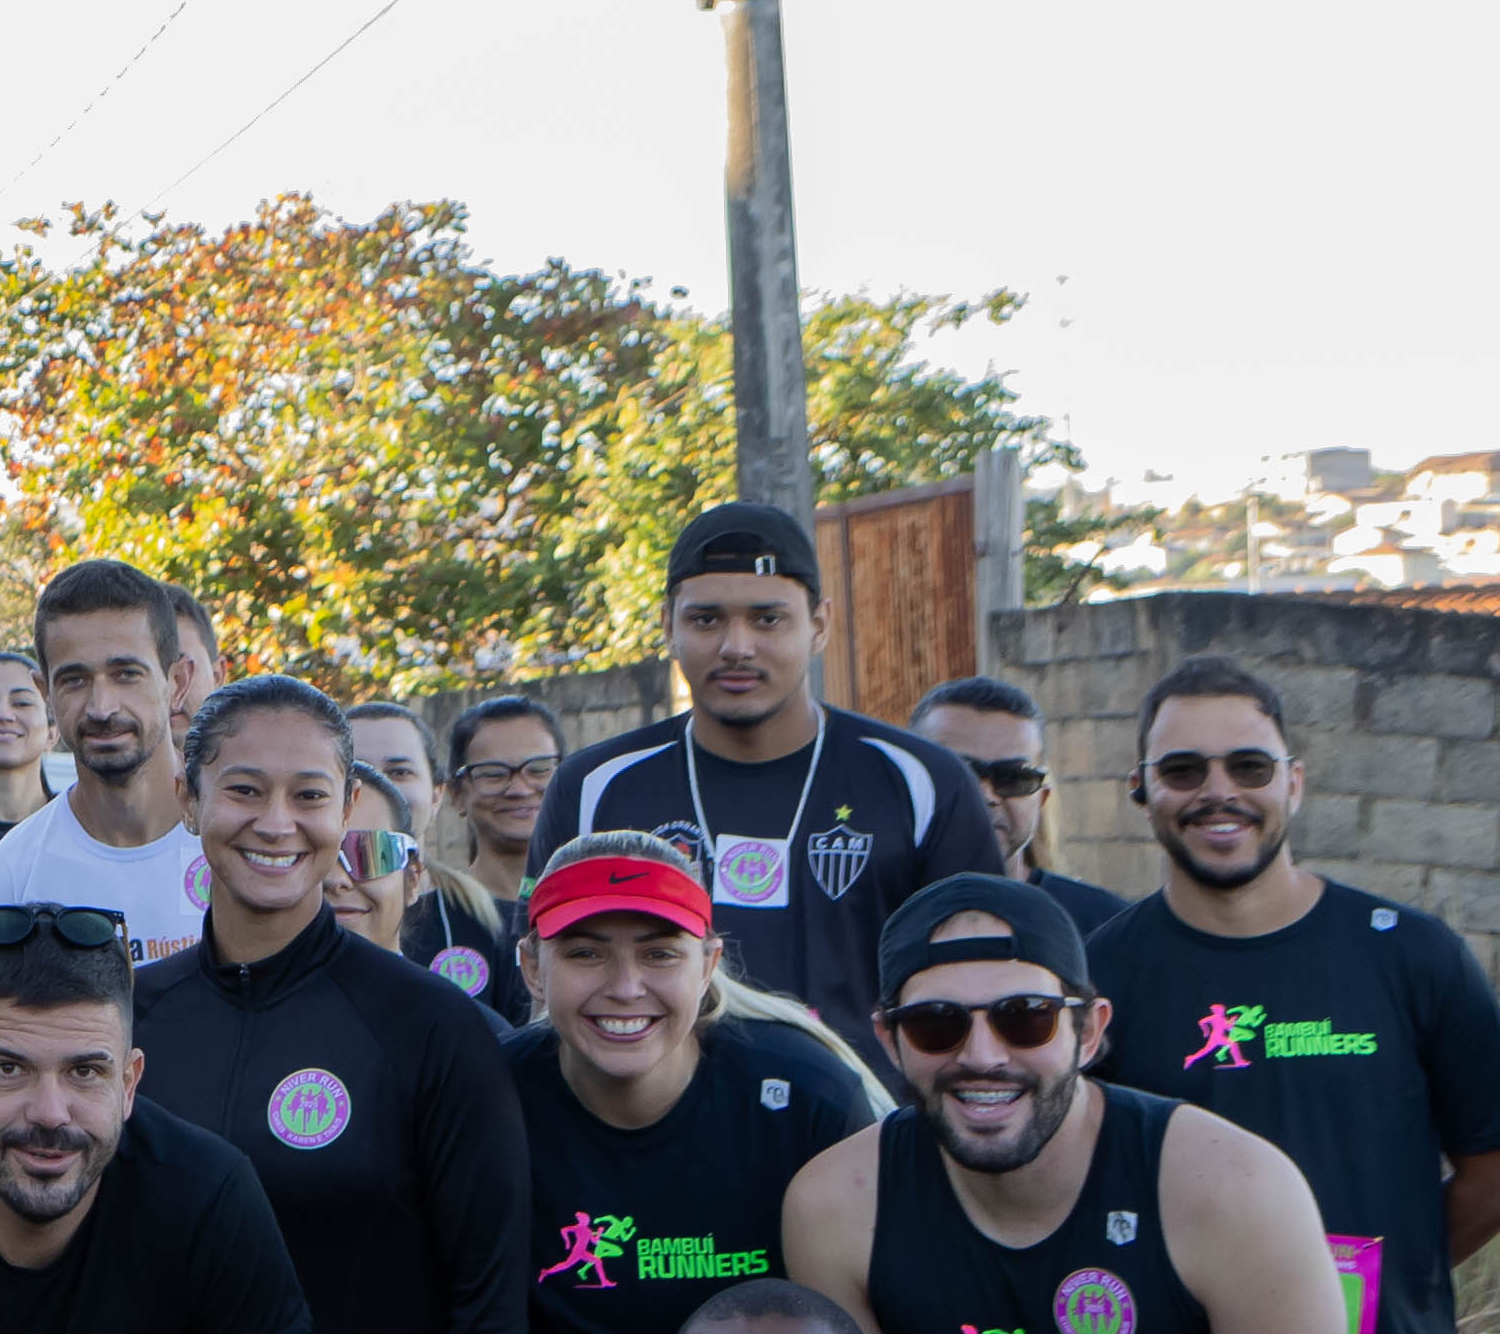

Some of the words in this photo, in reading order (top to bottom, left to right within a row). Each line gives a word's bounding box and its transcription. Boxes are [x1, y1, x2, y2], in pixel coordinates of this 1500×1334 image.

[816, 836, 865, 851] CAM
[1265, 1033, 1379, 1059] RUNNERS
[281, 1072, 317, 1095] NIVER
[318, 1074, 344, 1100] RUN
[637, 1232, 715, 1255] BAMBUÍ
[638, 1249, 769, 1280] RUNNERS
